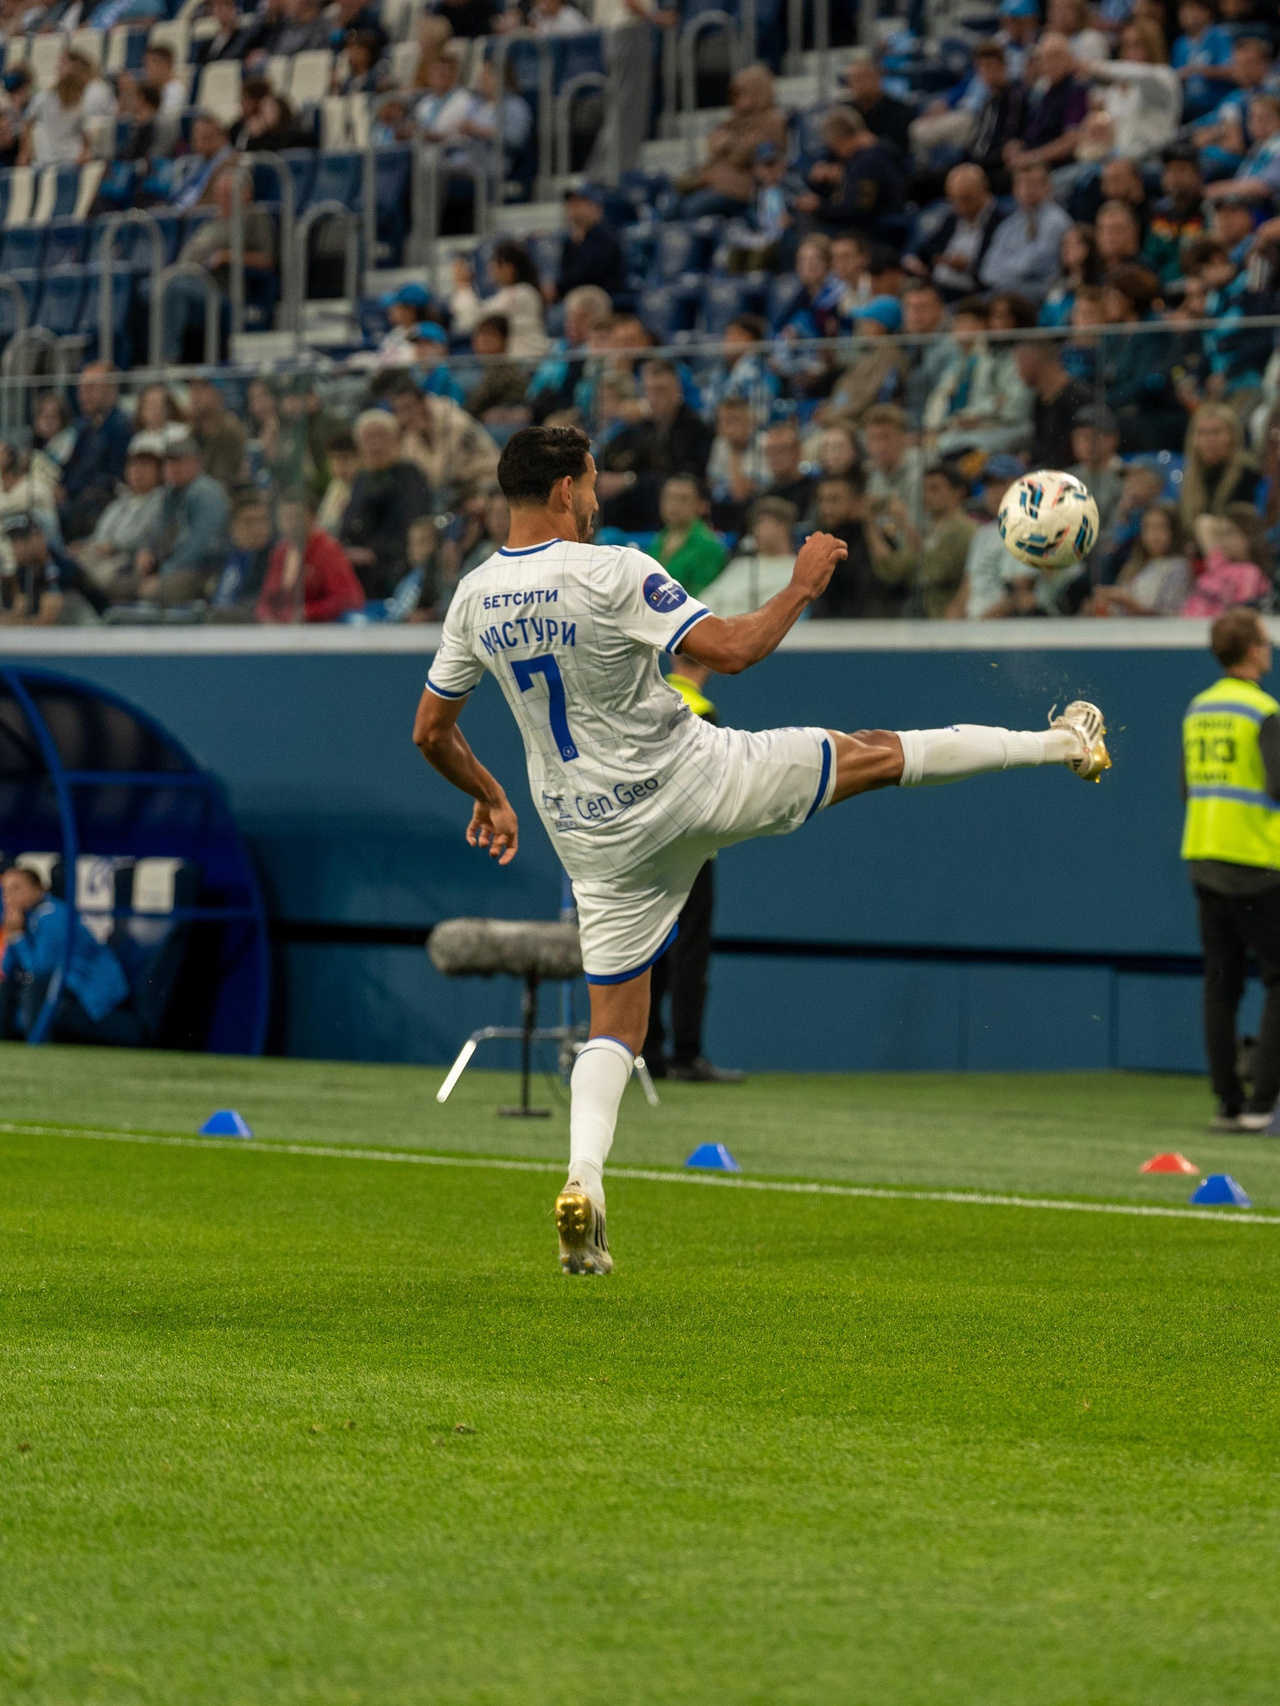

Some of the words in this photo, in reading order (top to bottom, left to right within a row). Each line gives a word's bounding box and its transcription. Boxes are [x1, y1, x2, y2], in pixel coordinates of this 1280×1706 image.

[483, 589, 559, 610] БЕТСИТИ
[479, 617, 577, 657] МАСТУРИ
[511, 653, 579, 763] 7
[575, 797, 613, 820] Cen
[613, 778, 659, 805] Geo
